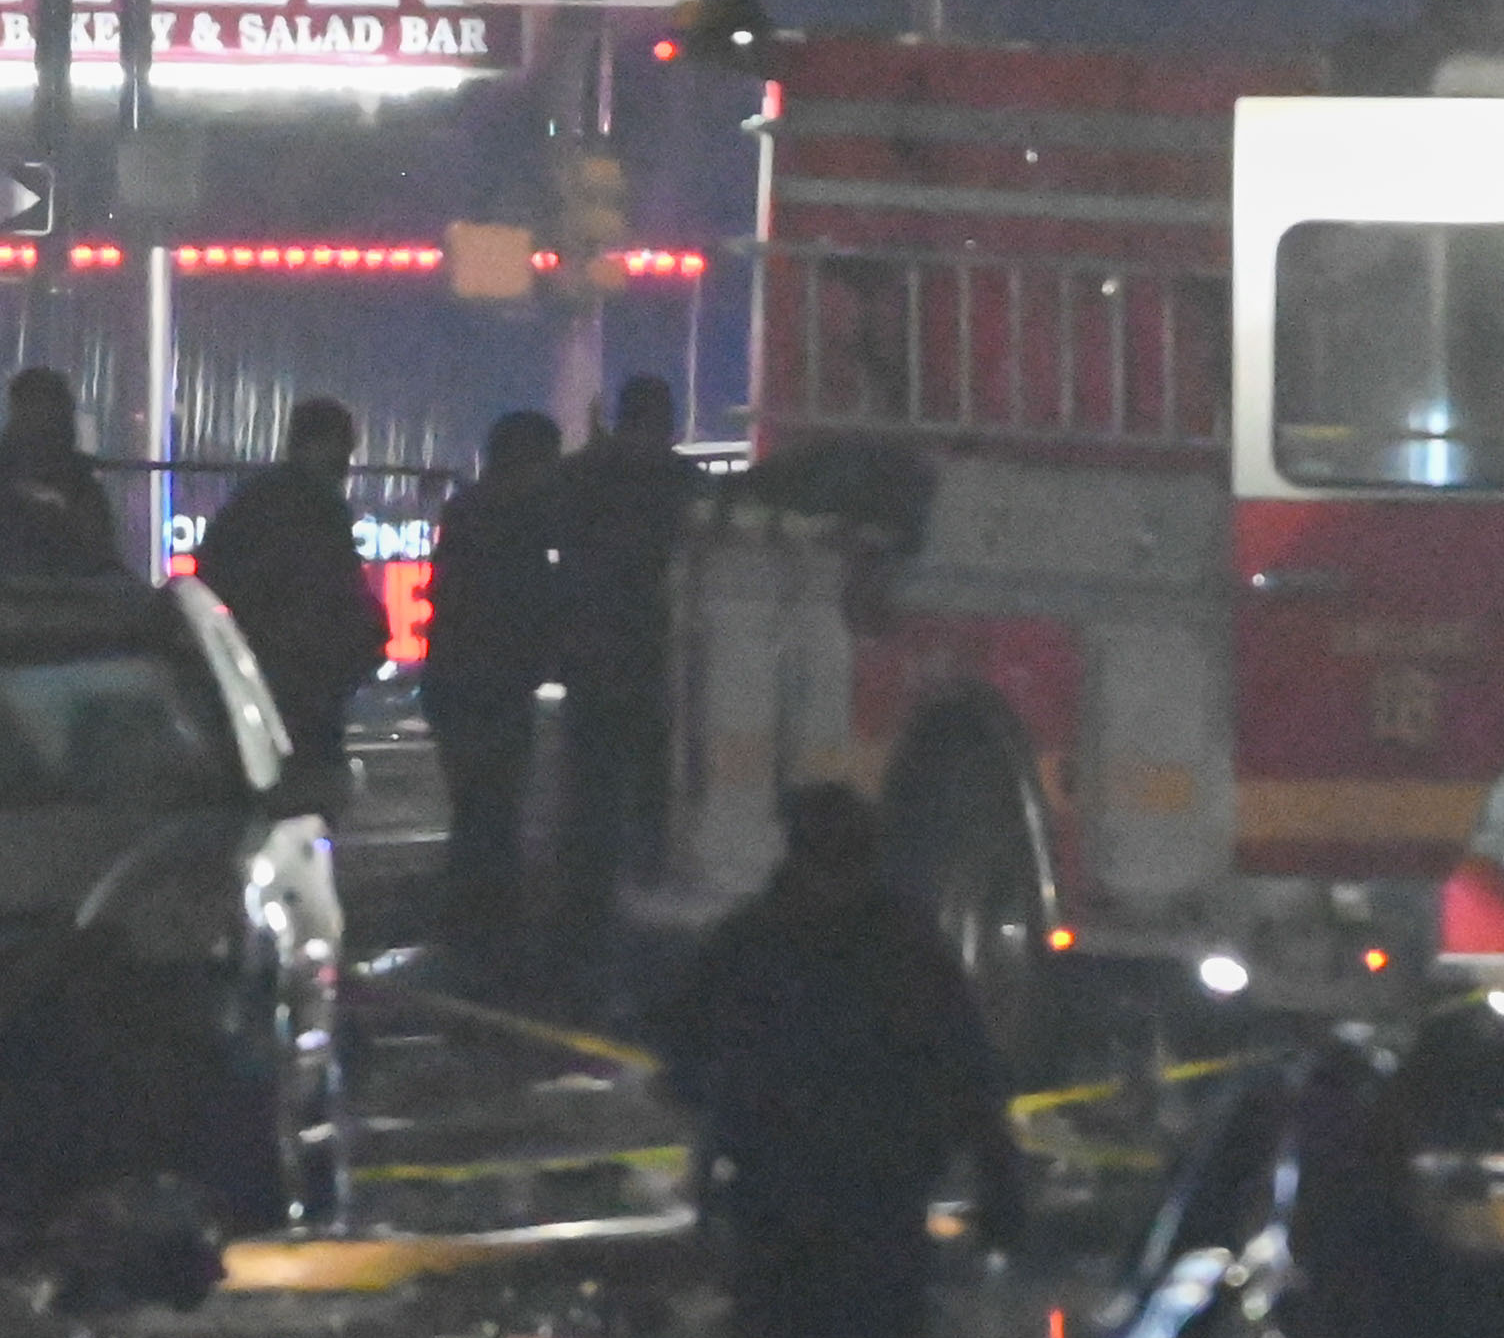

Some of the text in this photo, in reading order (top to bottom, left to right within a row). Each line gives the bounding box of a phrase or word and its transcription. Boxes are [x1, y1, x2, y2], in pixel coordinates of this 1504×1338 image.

[191, 13, 224, 51] &
[238, 14, 384, 53] SALAD
[398, 15, 488, 54] BAR
